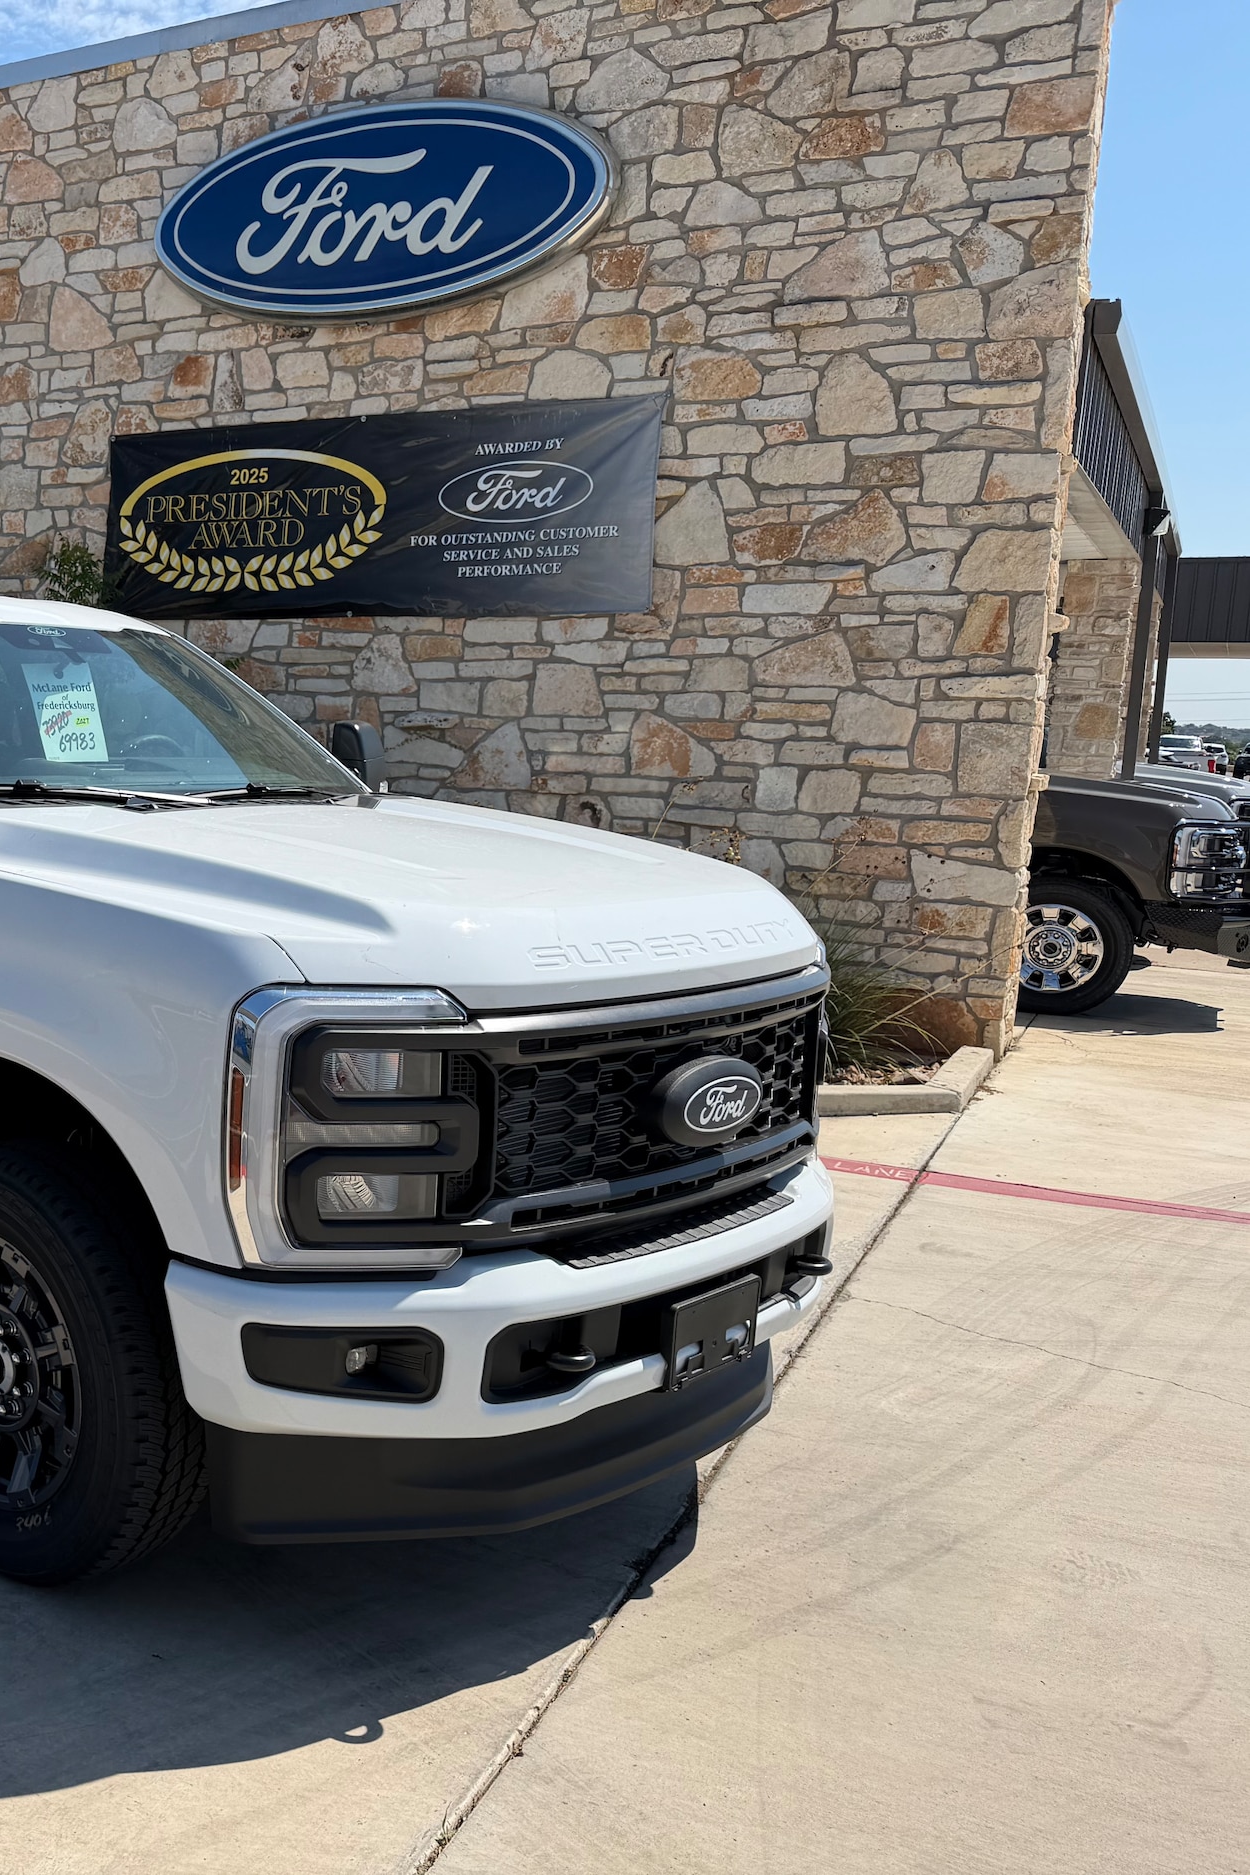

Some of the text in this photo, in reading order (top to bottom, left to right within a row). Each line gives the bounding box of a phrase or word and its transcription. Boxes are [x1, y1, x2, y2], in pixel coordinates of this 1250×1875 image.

[235, 148, 495, 275] Ford
[474, 438, 565, 456] AWARDED BY
[230, 467, 269, 485] 2025
[465, 469, 567, 512] Ford
[145, 484, 362, 524] PRESIDENT'S
[187, 518, 305, 550] AWARD
[410, 525, 619, 547] FOR OUTSTANDING CUSTOMER
[442, 544, 580, 562] SERVICE AND SALES
[456, 562, 563, 578] PERFORMANCE
[31, 682, 92, 692] McLane Ford
[62, 693, 69, 701] of
[36, 700, 96, 712] Fredericksburg
[59, 732, 96, 753] 69983
[526, 918, 795, 972] SUPER DUTY
[699, 1084, 748, 1126] Ford
[833, 1161, 914, 1180] LANE
